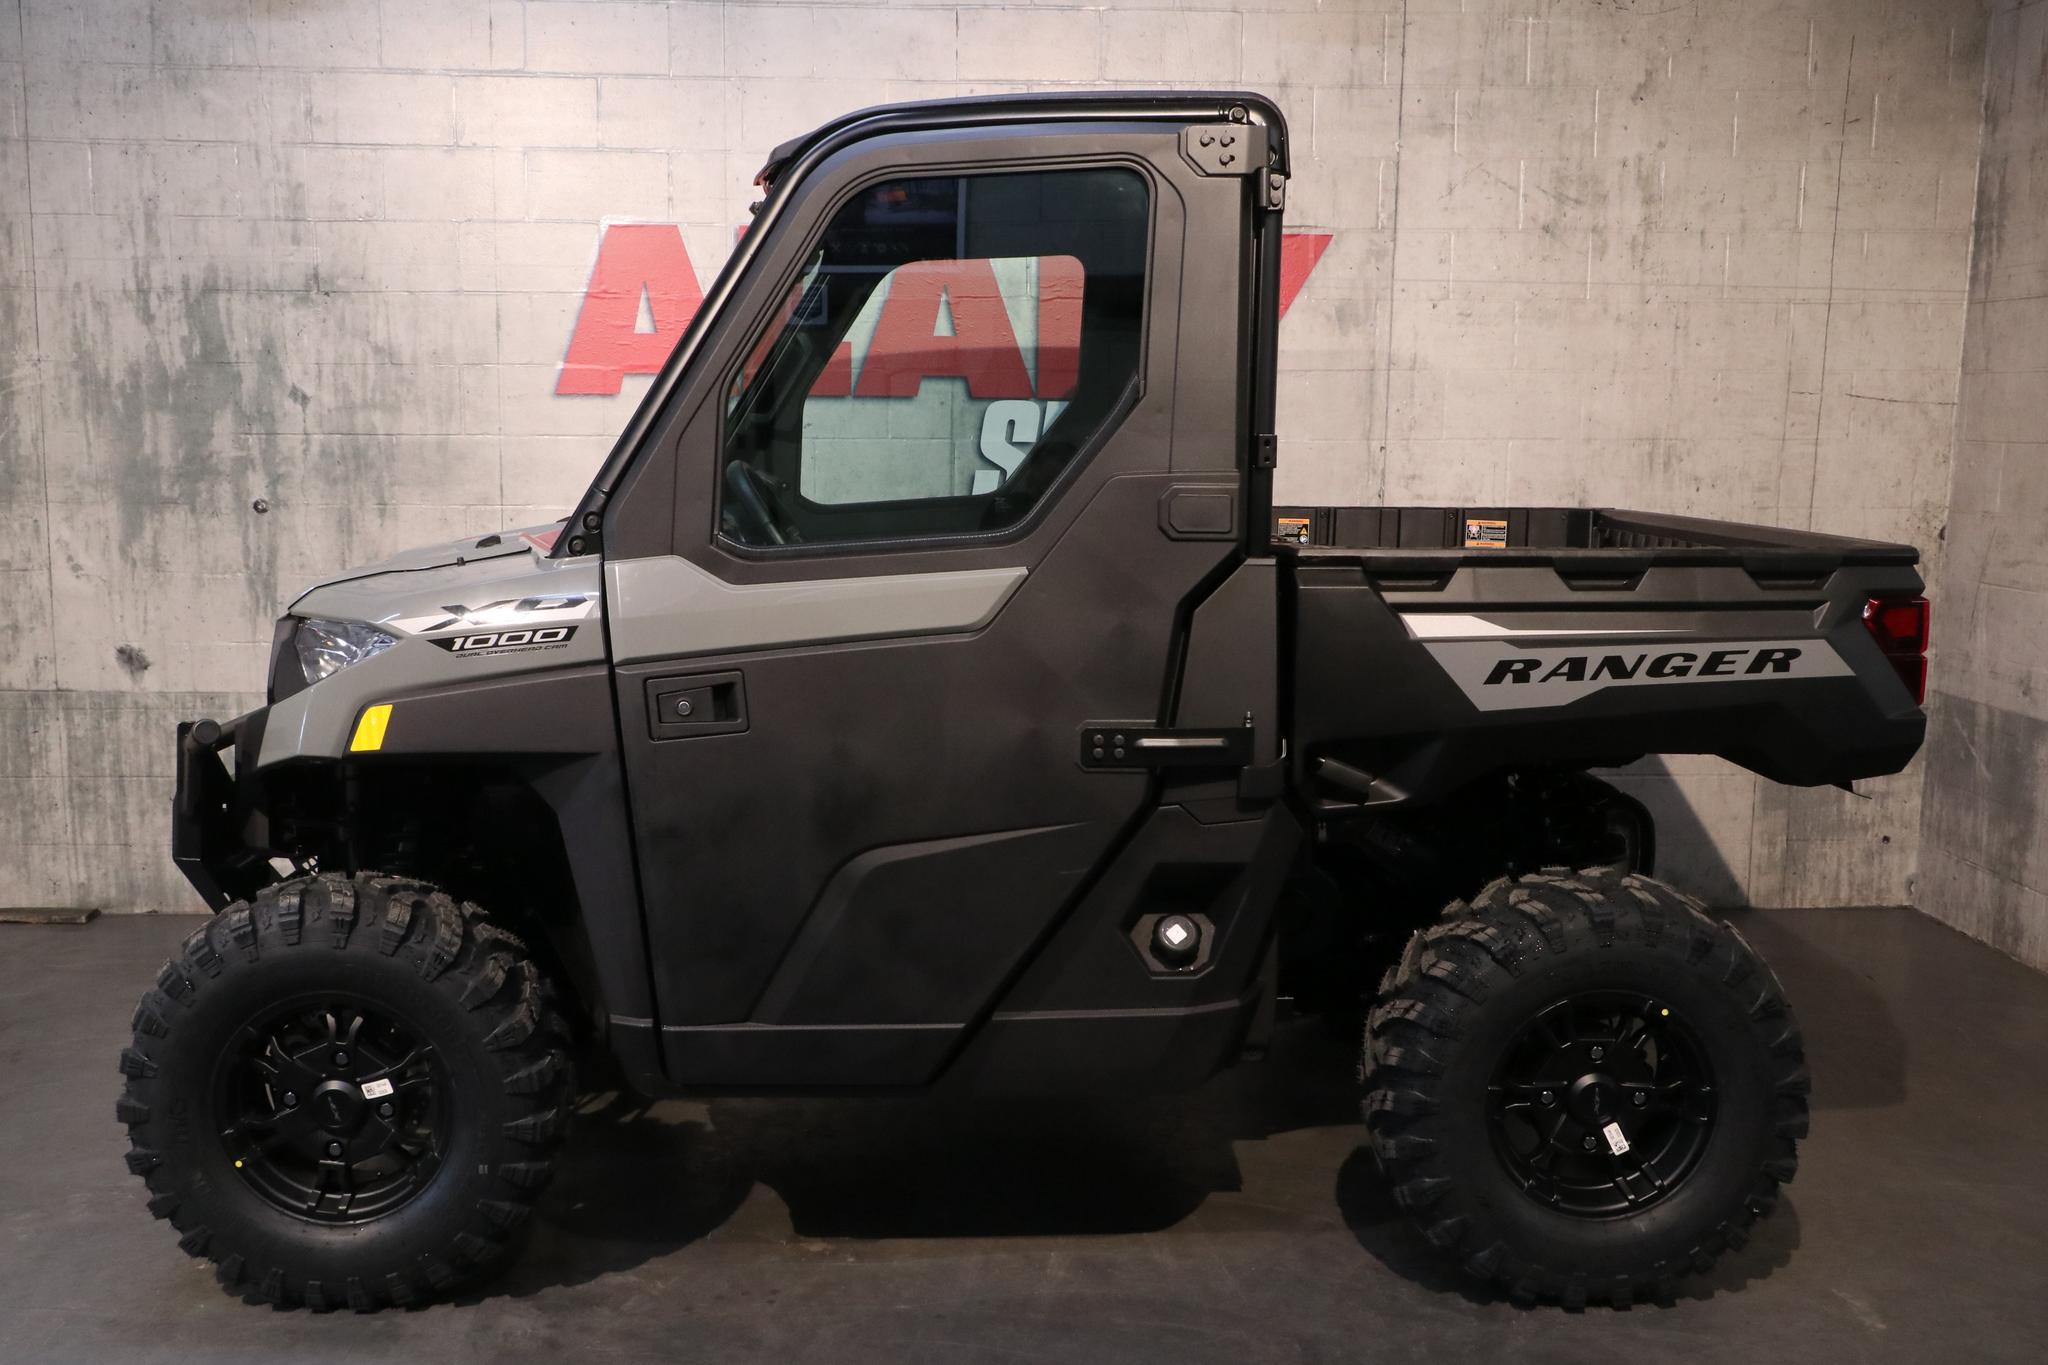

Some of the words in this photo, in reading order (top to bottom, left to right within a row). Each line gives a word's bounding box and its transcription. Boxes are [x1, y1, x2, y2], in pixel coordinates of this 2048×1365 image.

[452, 627, 569, 651] 1000
[455, 651, 484, 659] DUAL
[486, 646, 542, 656] OVERHEAD
[1483, 647, 1802, 686] RANGER
